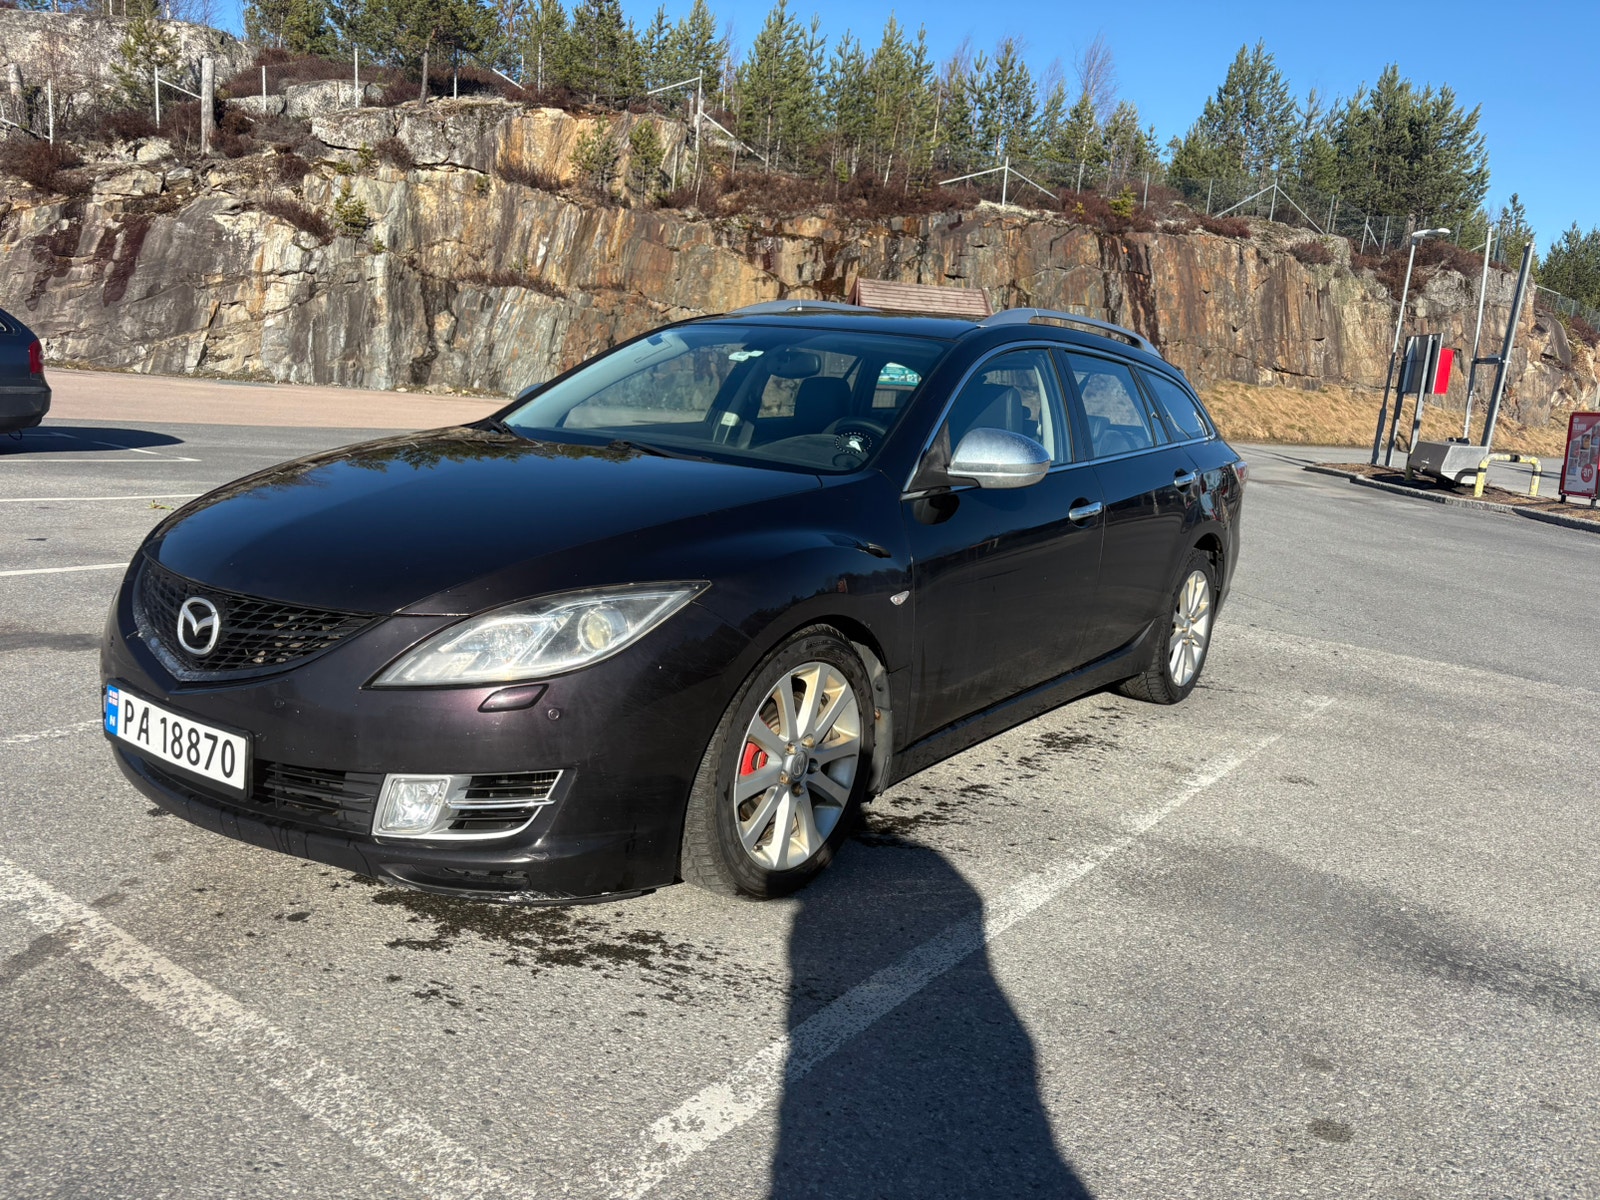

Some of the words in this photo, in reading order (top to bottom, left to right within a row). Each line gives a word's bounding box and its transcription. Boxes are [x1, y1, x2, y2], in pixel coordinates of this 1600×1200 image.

[109, 714, 116, 727] N
[124, 699, 149, 745] PA
[160, 717, 235, 778] 18870
